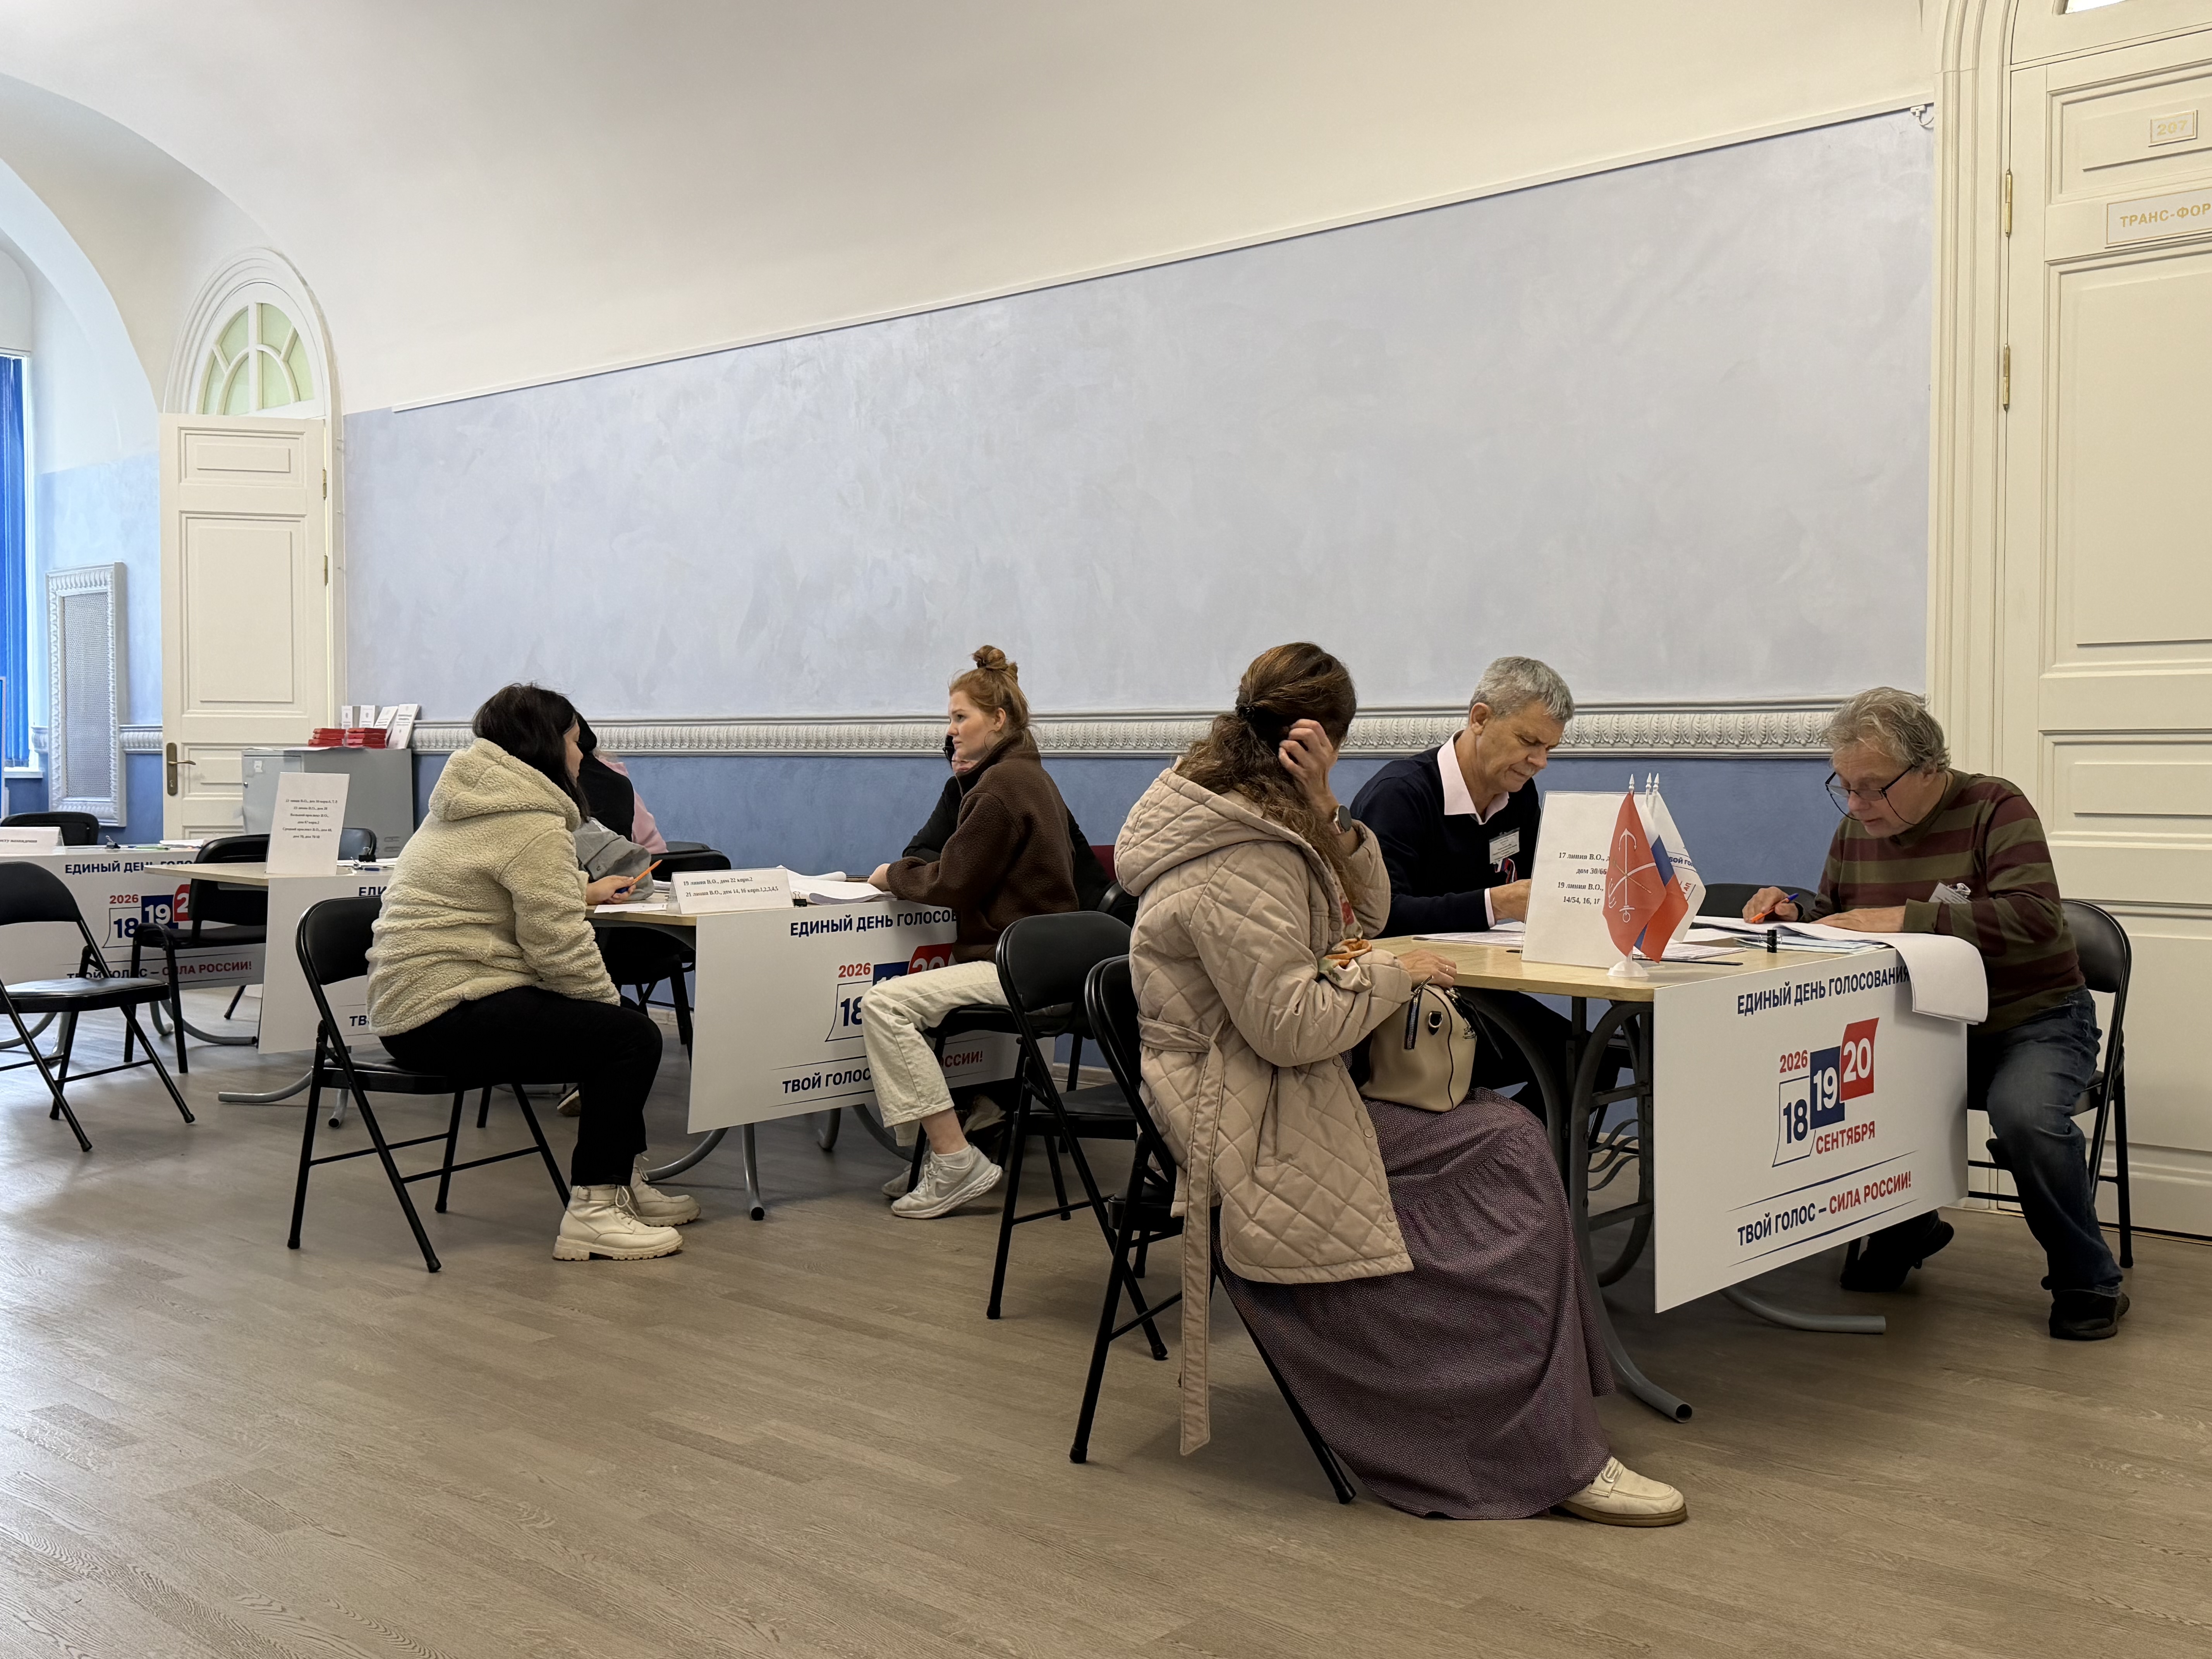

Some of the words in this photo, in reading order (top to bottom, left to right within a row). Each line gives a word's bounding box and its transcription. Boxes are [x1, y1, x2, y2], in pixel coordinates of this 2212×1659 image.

[2157, 120, 2188, 136] 207
[2120, 203, 2211, 227] ТРАНС-ФОР
[65, 860, 120, 875] ЕДИНЫЙ
[124, 862, 153, 873] ДЕН
[109, 894, 139, 904] 2026
[177, 892, 189, 913] 2
[1563, 896, 1581, 904] 14/54,
[145, 904, 171, 924] 19
[790, 914, 853, 937] ЕДИНЫЙ
[856, 914, 893, 933] ДЕНЬ
[897, 910, 957, 927] ГОЛОСО
[113, 917, 139, 938] 18
[162, 965, 196, 975] СЛА
[199, 961, 252, 973] РОССИИ!
[838, 962, 871, 978] 2026
[1738, 981, 1791, 1016] ЕДИНЫЙ
[1794, 981, 1826, 1006] ДЕНЬ
[1829, 965, 1909, 997] ГОЛОСОВАНИЯ
[840, 996, 863, 1027] 18
[1779, 1049, 1808, 1073] 2026
[1843, 1038, 1871, 1083] 20
[782, 1072, 821, 1094] ТВОЙ
[825, 1067, 871, 1087] ГОЛОС
[1813, 1067, 1838, 1111] 19
[1783, 1099, 1808, 1144] 18
[1816, 1120, 1875, 1154] СЕНТЯБРЯ
[1738, 1212, 1771, 1246] ТВОЙ
[1775, 1203, 1815, 1233] ГОЛОС
[1829, 1188, 1861, 1214] СИЛА
[1864, 1171, 1911, 1203] РОССИИ!
